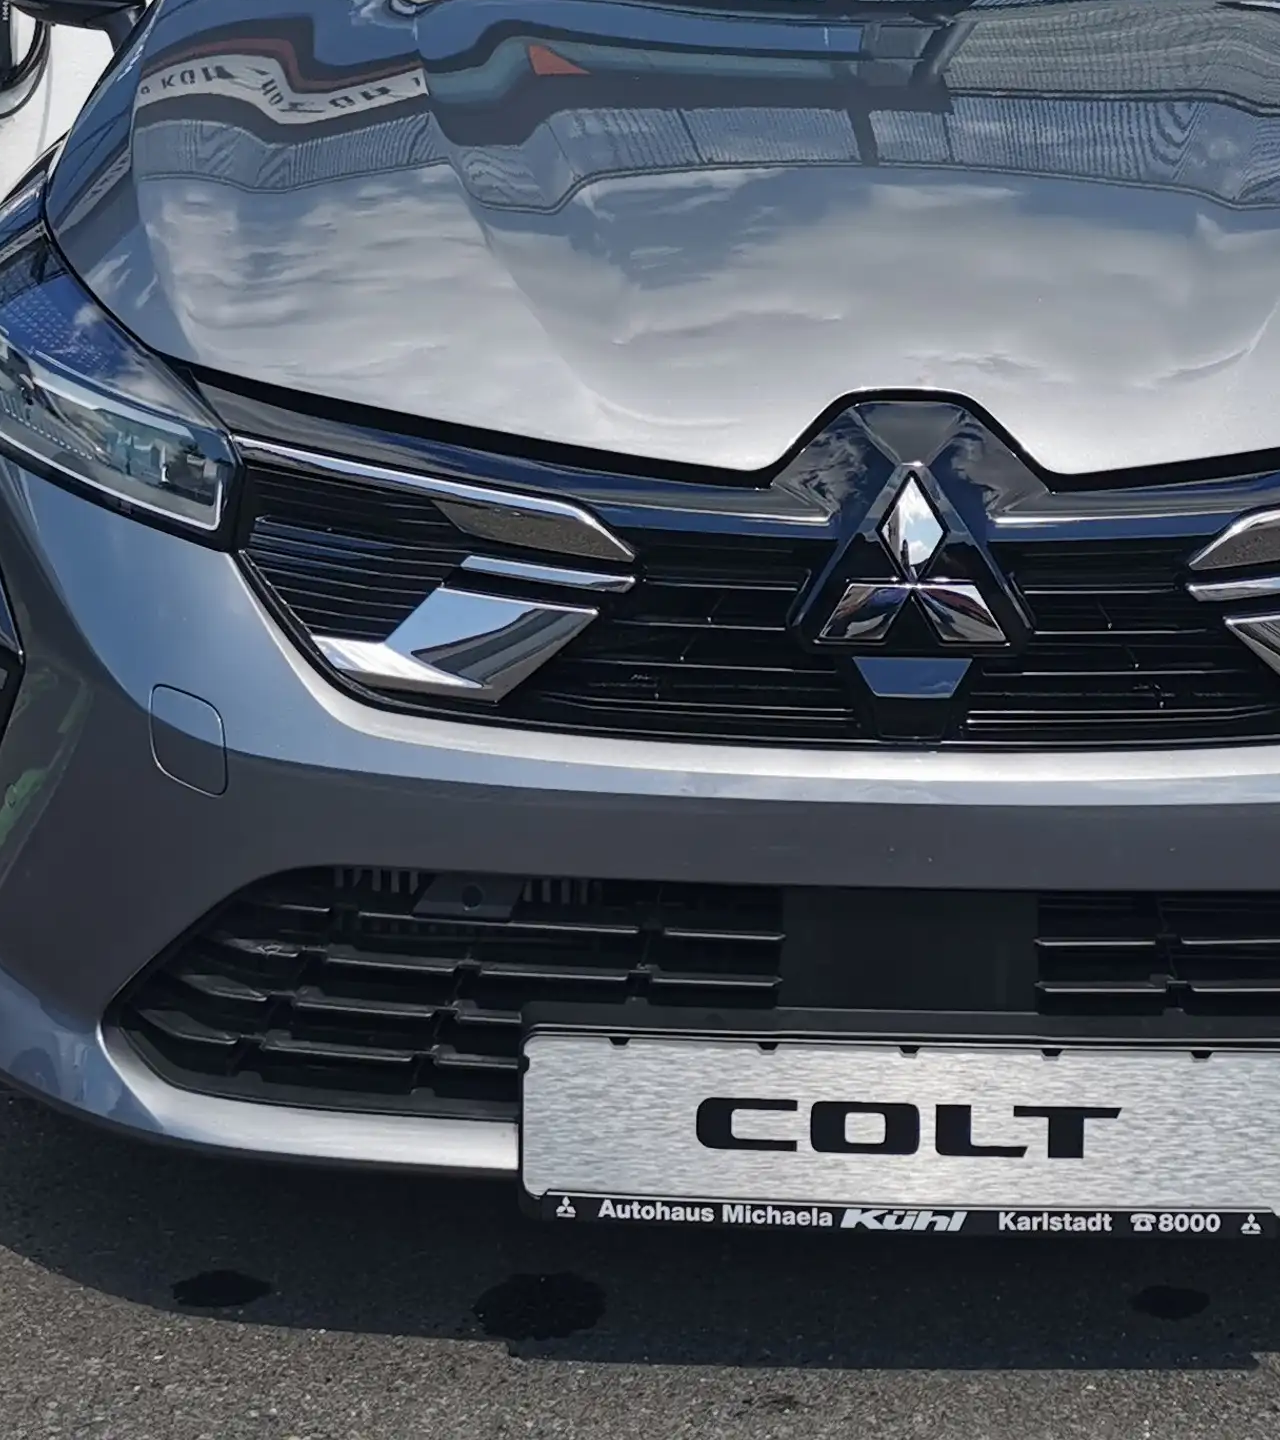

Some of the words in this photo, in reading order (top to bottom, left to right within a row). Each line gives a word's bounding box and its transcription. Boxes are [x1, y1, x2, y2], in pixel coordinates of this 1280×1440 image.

[696, 1097, 1121, 1159] COLT
[597, 1198, 715, 1223] Autohaus
[721, 1203, 834, 1227] Michaela
[840, 1208, 968, 1232] Kühl
[998, 1211, 1113, 1233] Karlstadt
